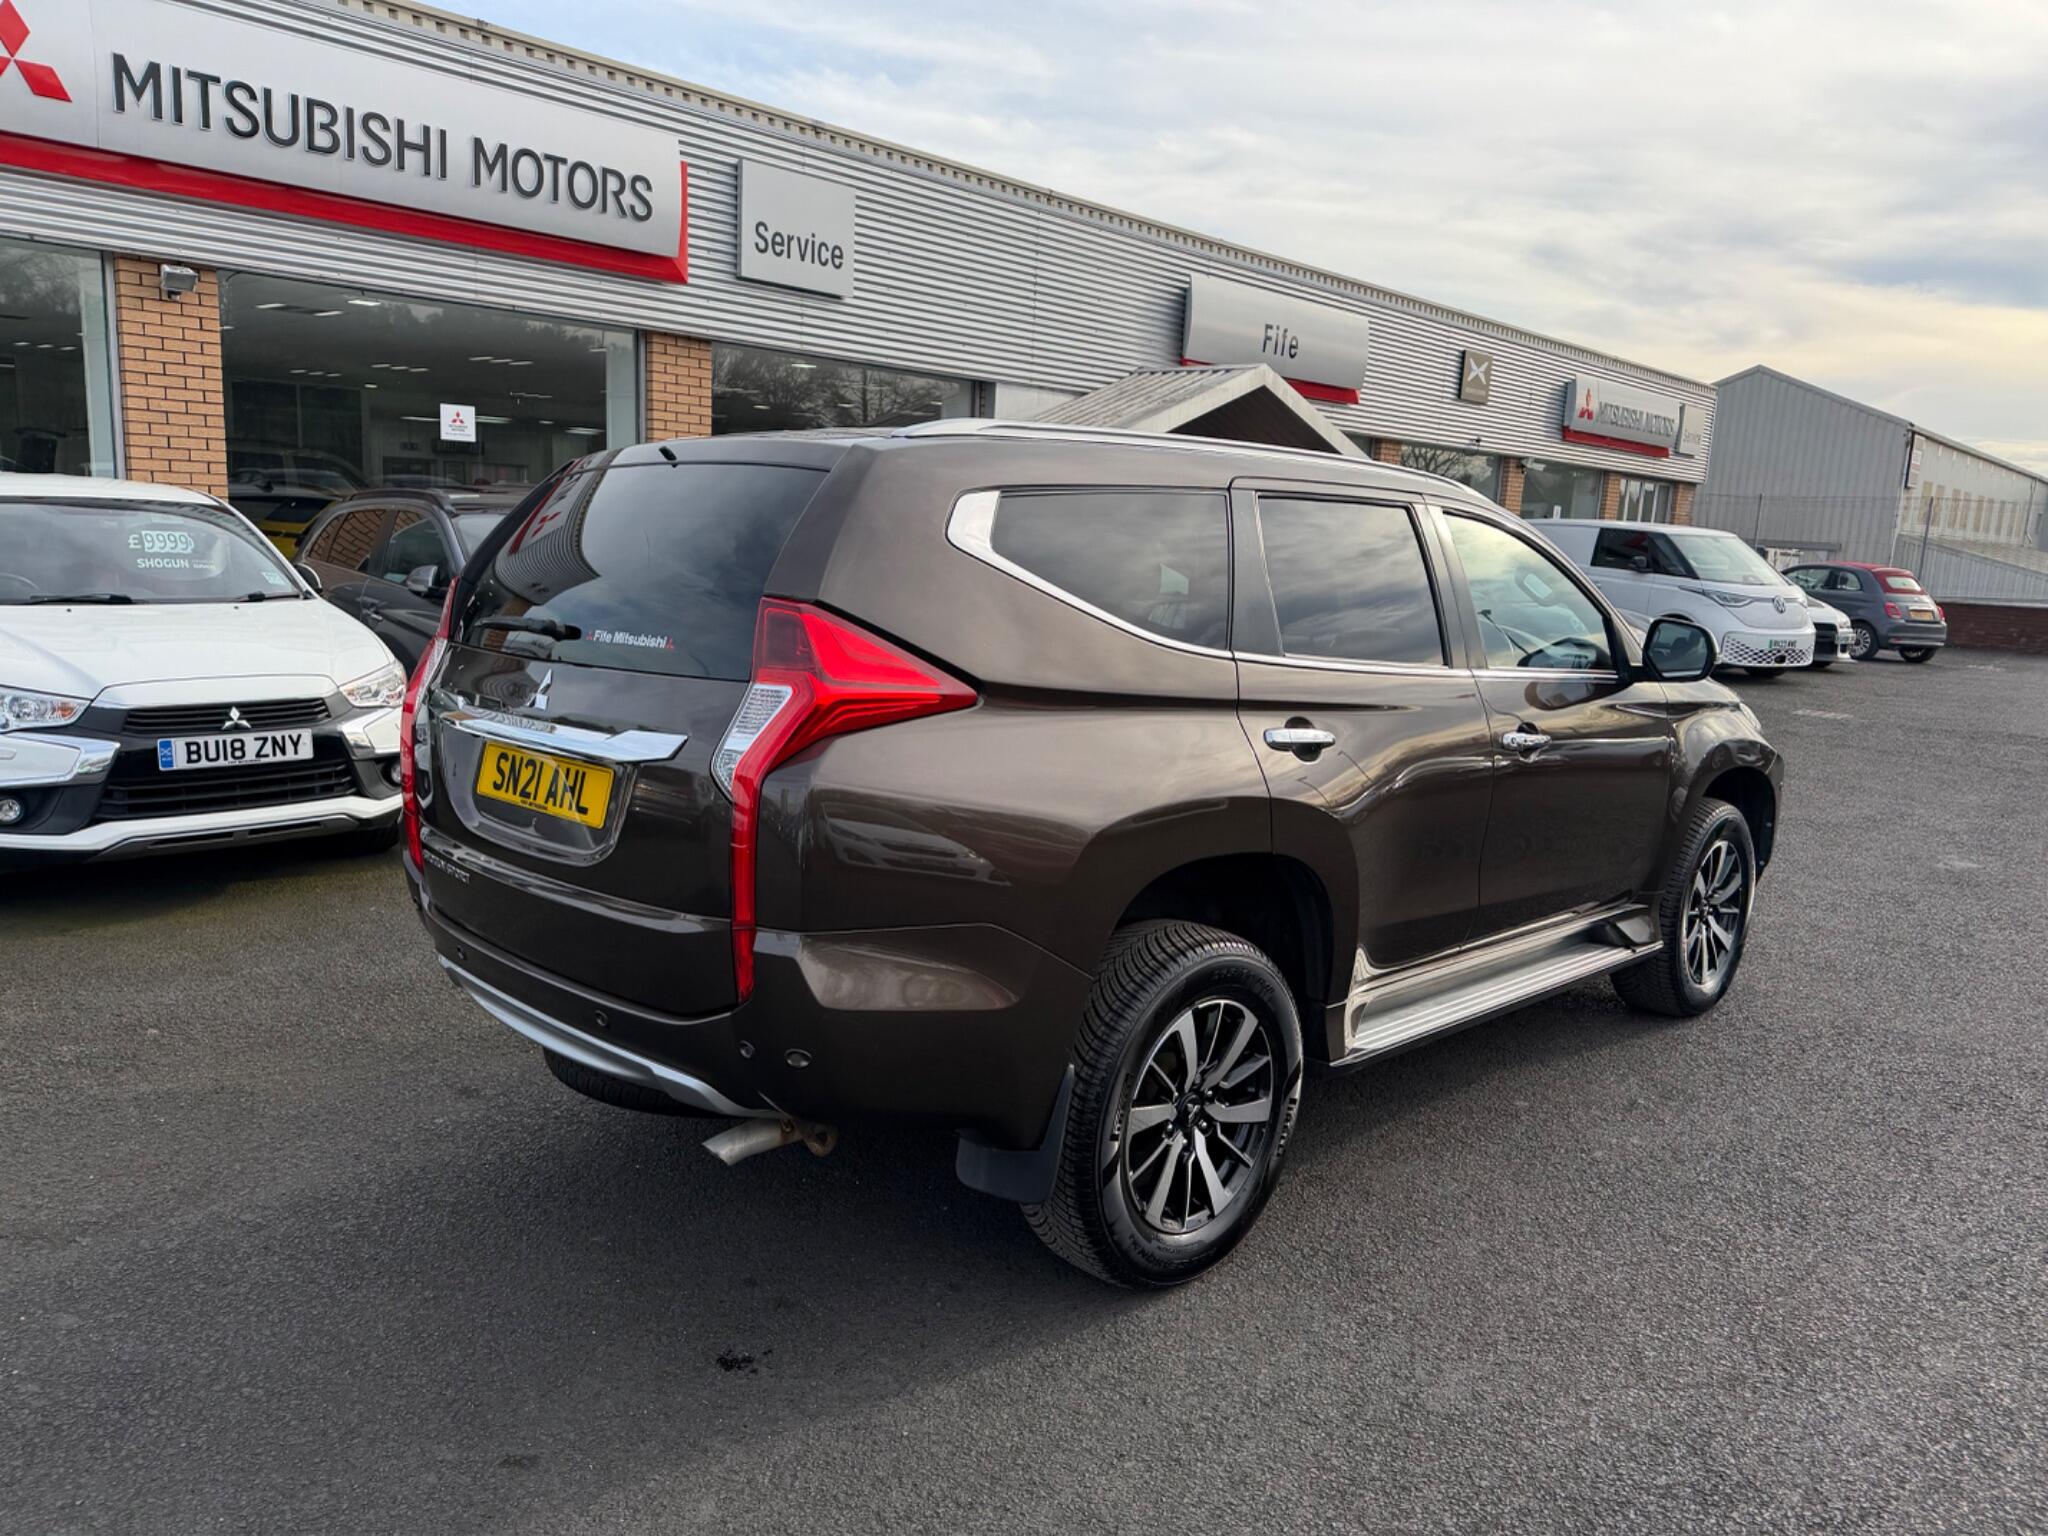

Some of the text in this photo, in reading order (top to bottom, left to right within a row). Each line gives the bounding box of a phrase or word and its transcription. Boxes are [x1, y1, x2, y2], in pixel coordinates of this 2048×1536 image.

[112, 52, 654, 223] MITSUBISHI MOTORS
[754, 220, 845, 270] Service
[1262, 323, 1299, 359] Fife
[136, 557, 190, 569] SHOGUN
[593, 629, 668, 649] Fife Mitsubishi
[184, 733, 303, 765] BU18 ZNY
[492, 750, 589, 816] SN21 AHL
